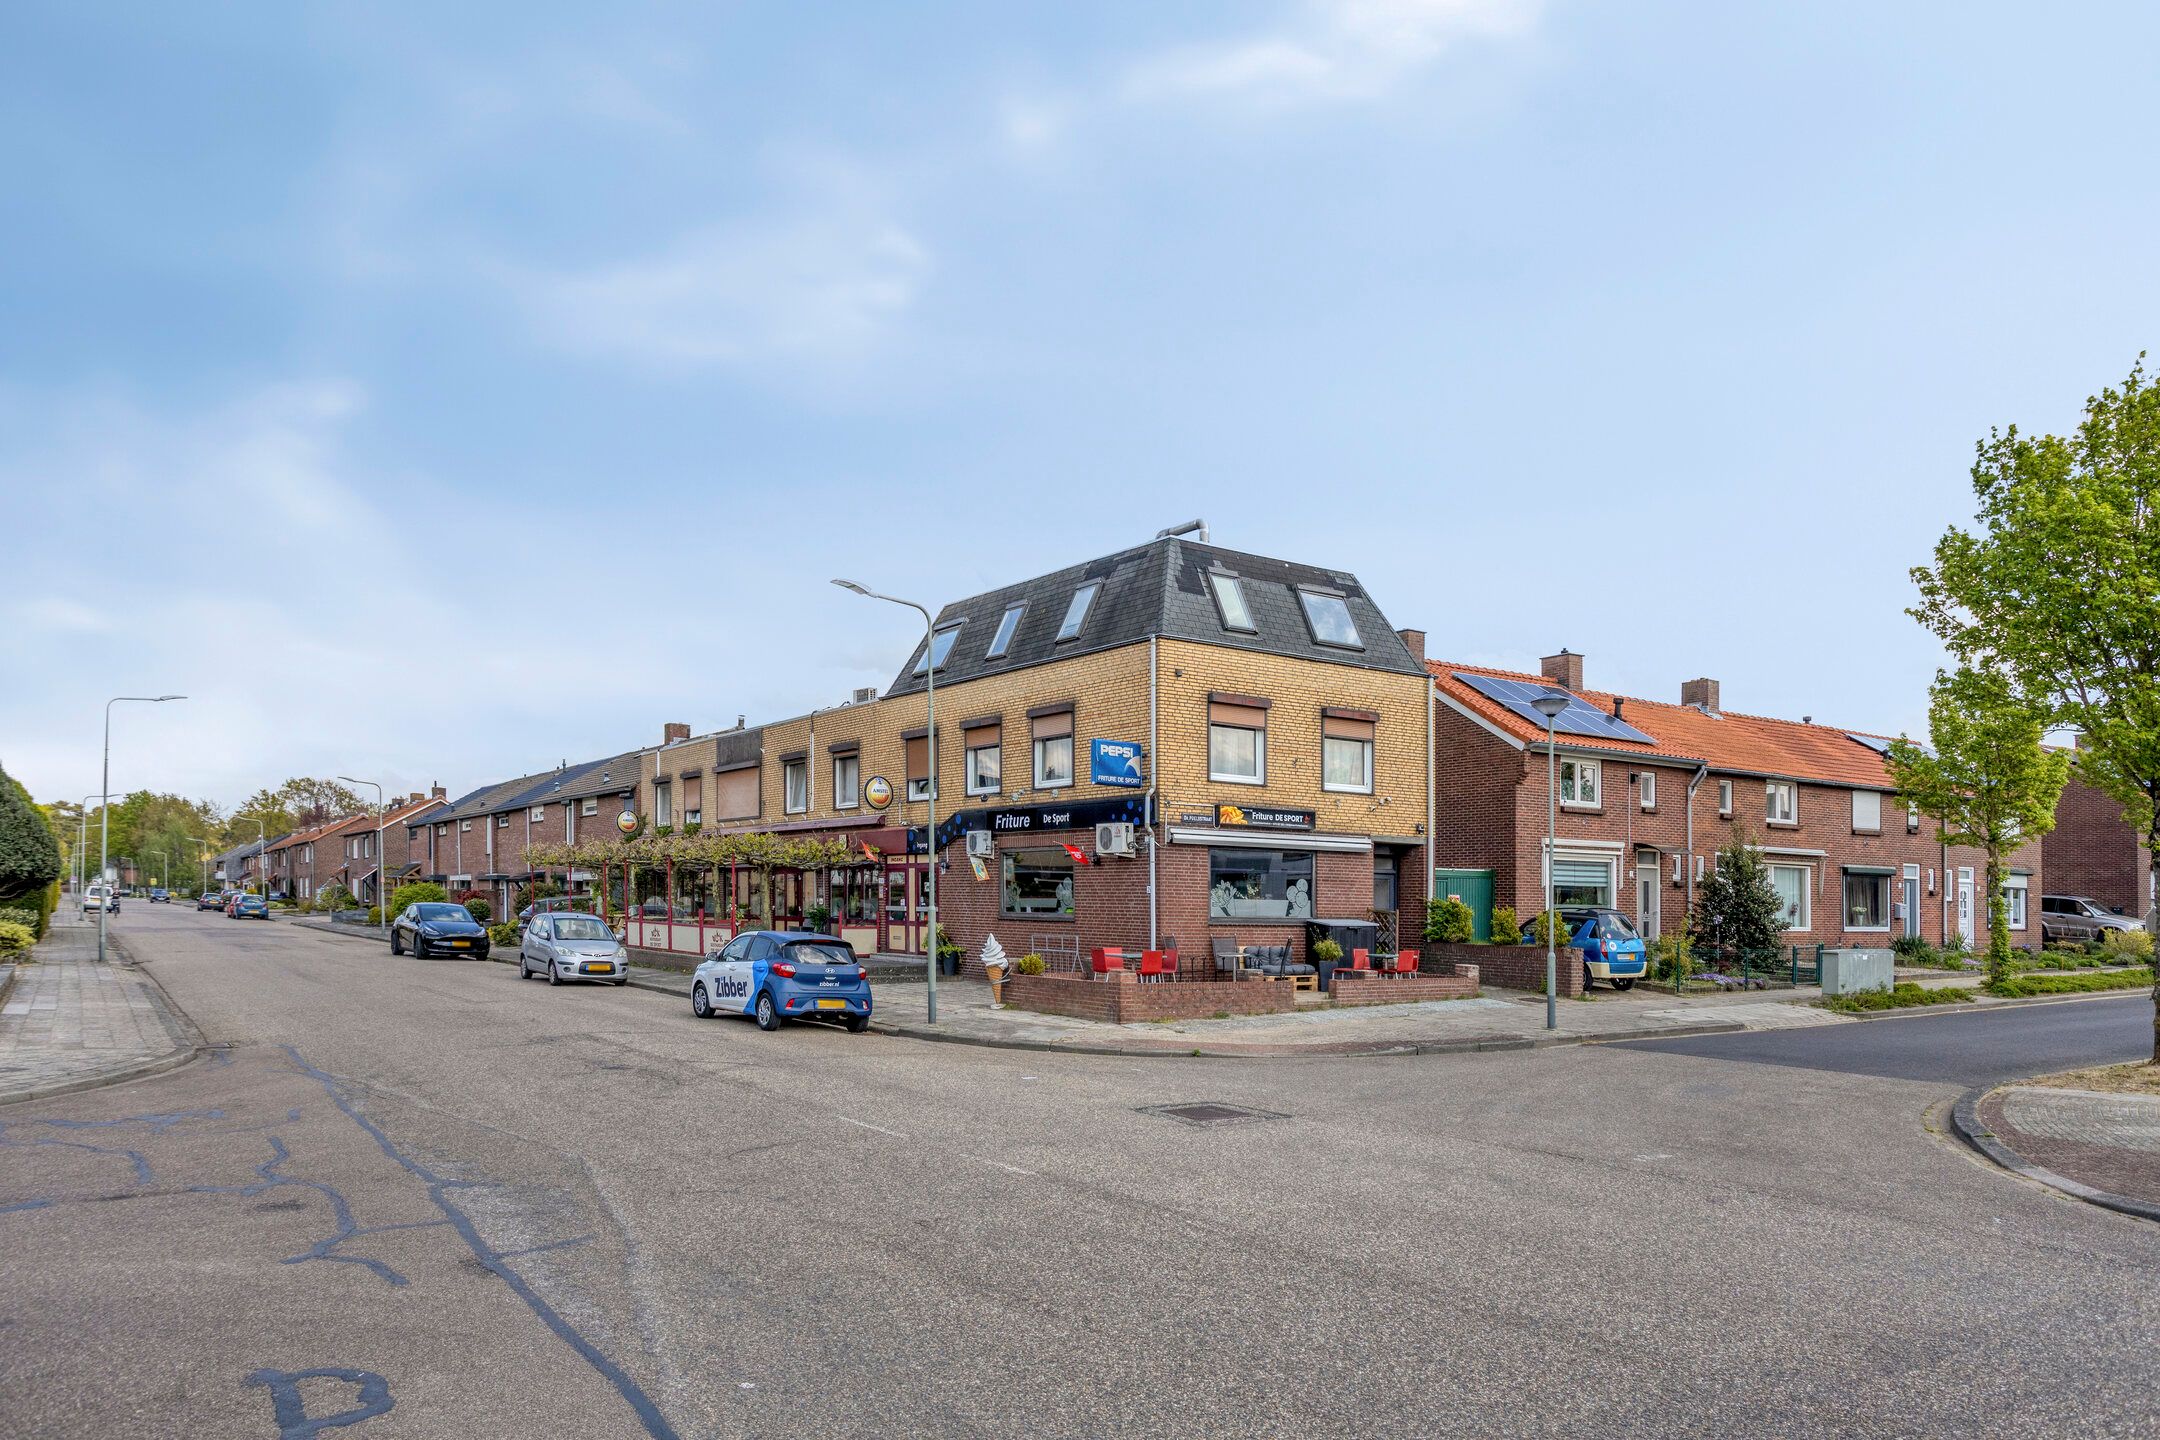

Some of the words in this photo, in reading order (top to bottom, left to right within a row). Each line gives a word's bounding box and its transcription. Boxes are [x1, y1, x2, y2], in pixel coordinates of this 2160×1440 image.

[1100, 744, 1133, 758] PEPSI
[1097, 774, 1117, 783] FRITURE
[1125, 777, 1140, 785] SPORT
[995, 813, 1031, 829] Friture
[1043, 814, 1052, 824] De
[1052, 812, 1070, 826] Sport
[1252, 811, 1274, 821] Friture
[1275, 813, 1284, 821] DE
[1284, 814, 1304, 823] SPORT
[714, 976, 748, 998] Zibber
